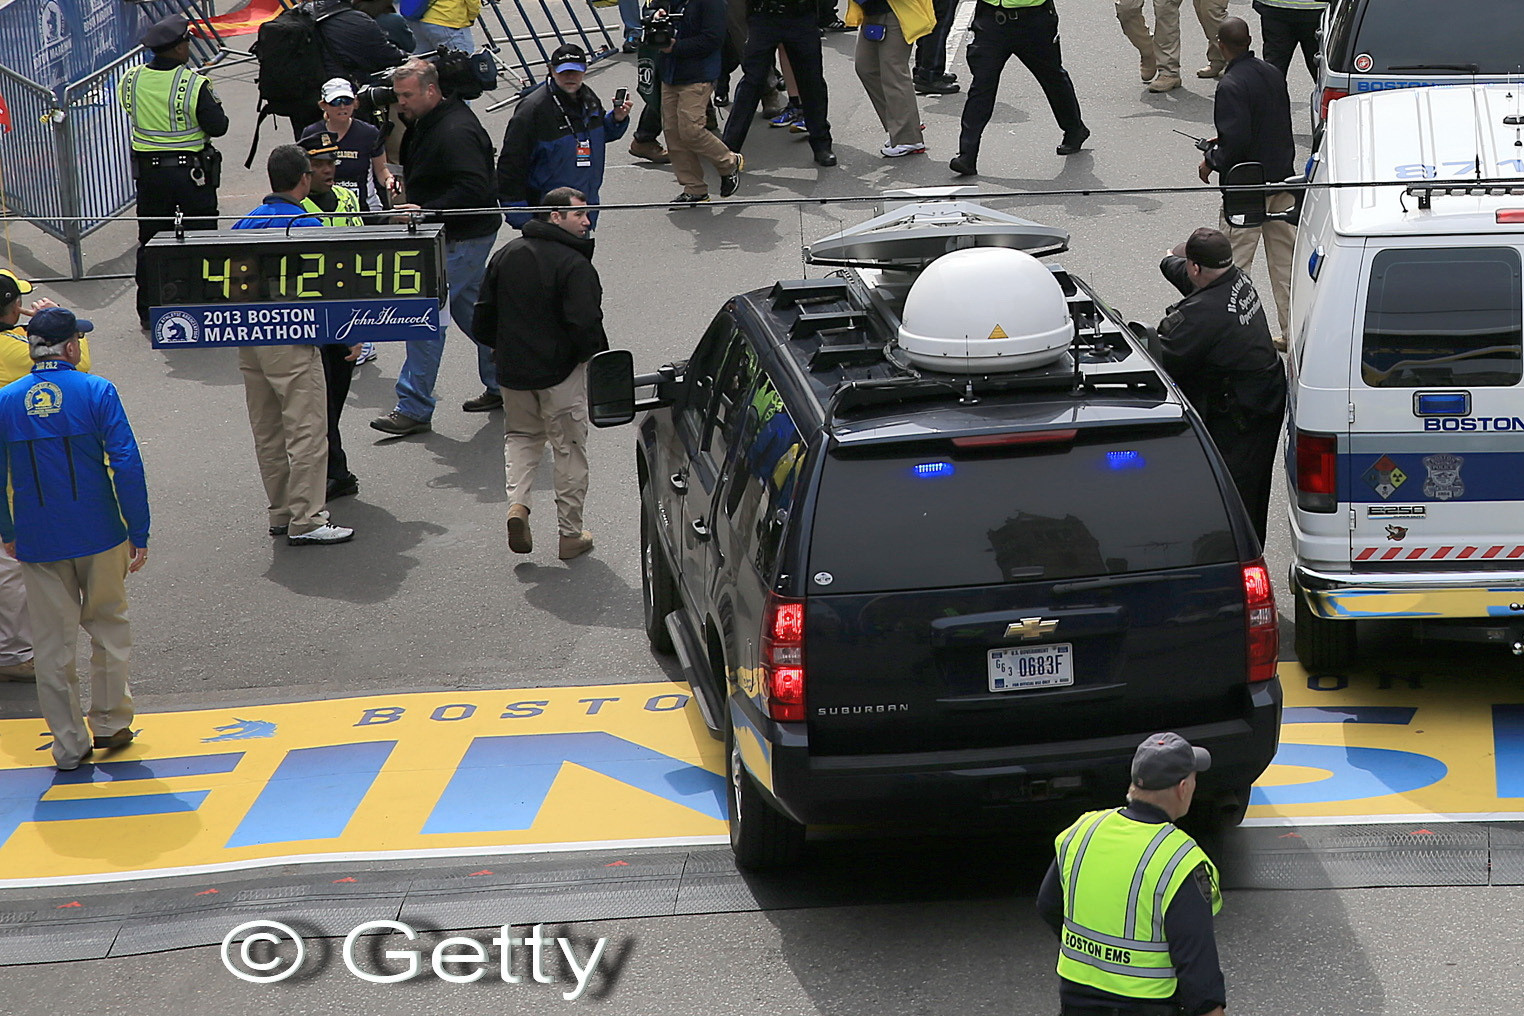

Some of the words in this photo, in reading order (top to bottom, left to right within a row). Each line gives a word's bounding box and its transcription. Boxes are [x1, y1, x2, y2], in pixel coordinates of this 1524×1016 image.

[176, 77, 188, 124] POLICE
[202, 250, 422, 300] 4:12:46
[203, 310, 242, 326] 2013
[247, 308, 316, 324] BOSTON
[334, 308, 377, 340] John
[374, 305, 438, 332] Hancock
[204, 324, 318, 343] MARATHON
[45, 361, 58, 370] 26.2
[1019, 653, 1064, 678] 0683F
[354, 693, 690, 727] BOSTO
[818, 703, 910, 716] SUBURBAN
[1065, 932, 1102, 958] BOSTON
[1104, 947, 1131, 965] EMS
